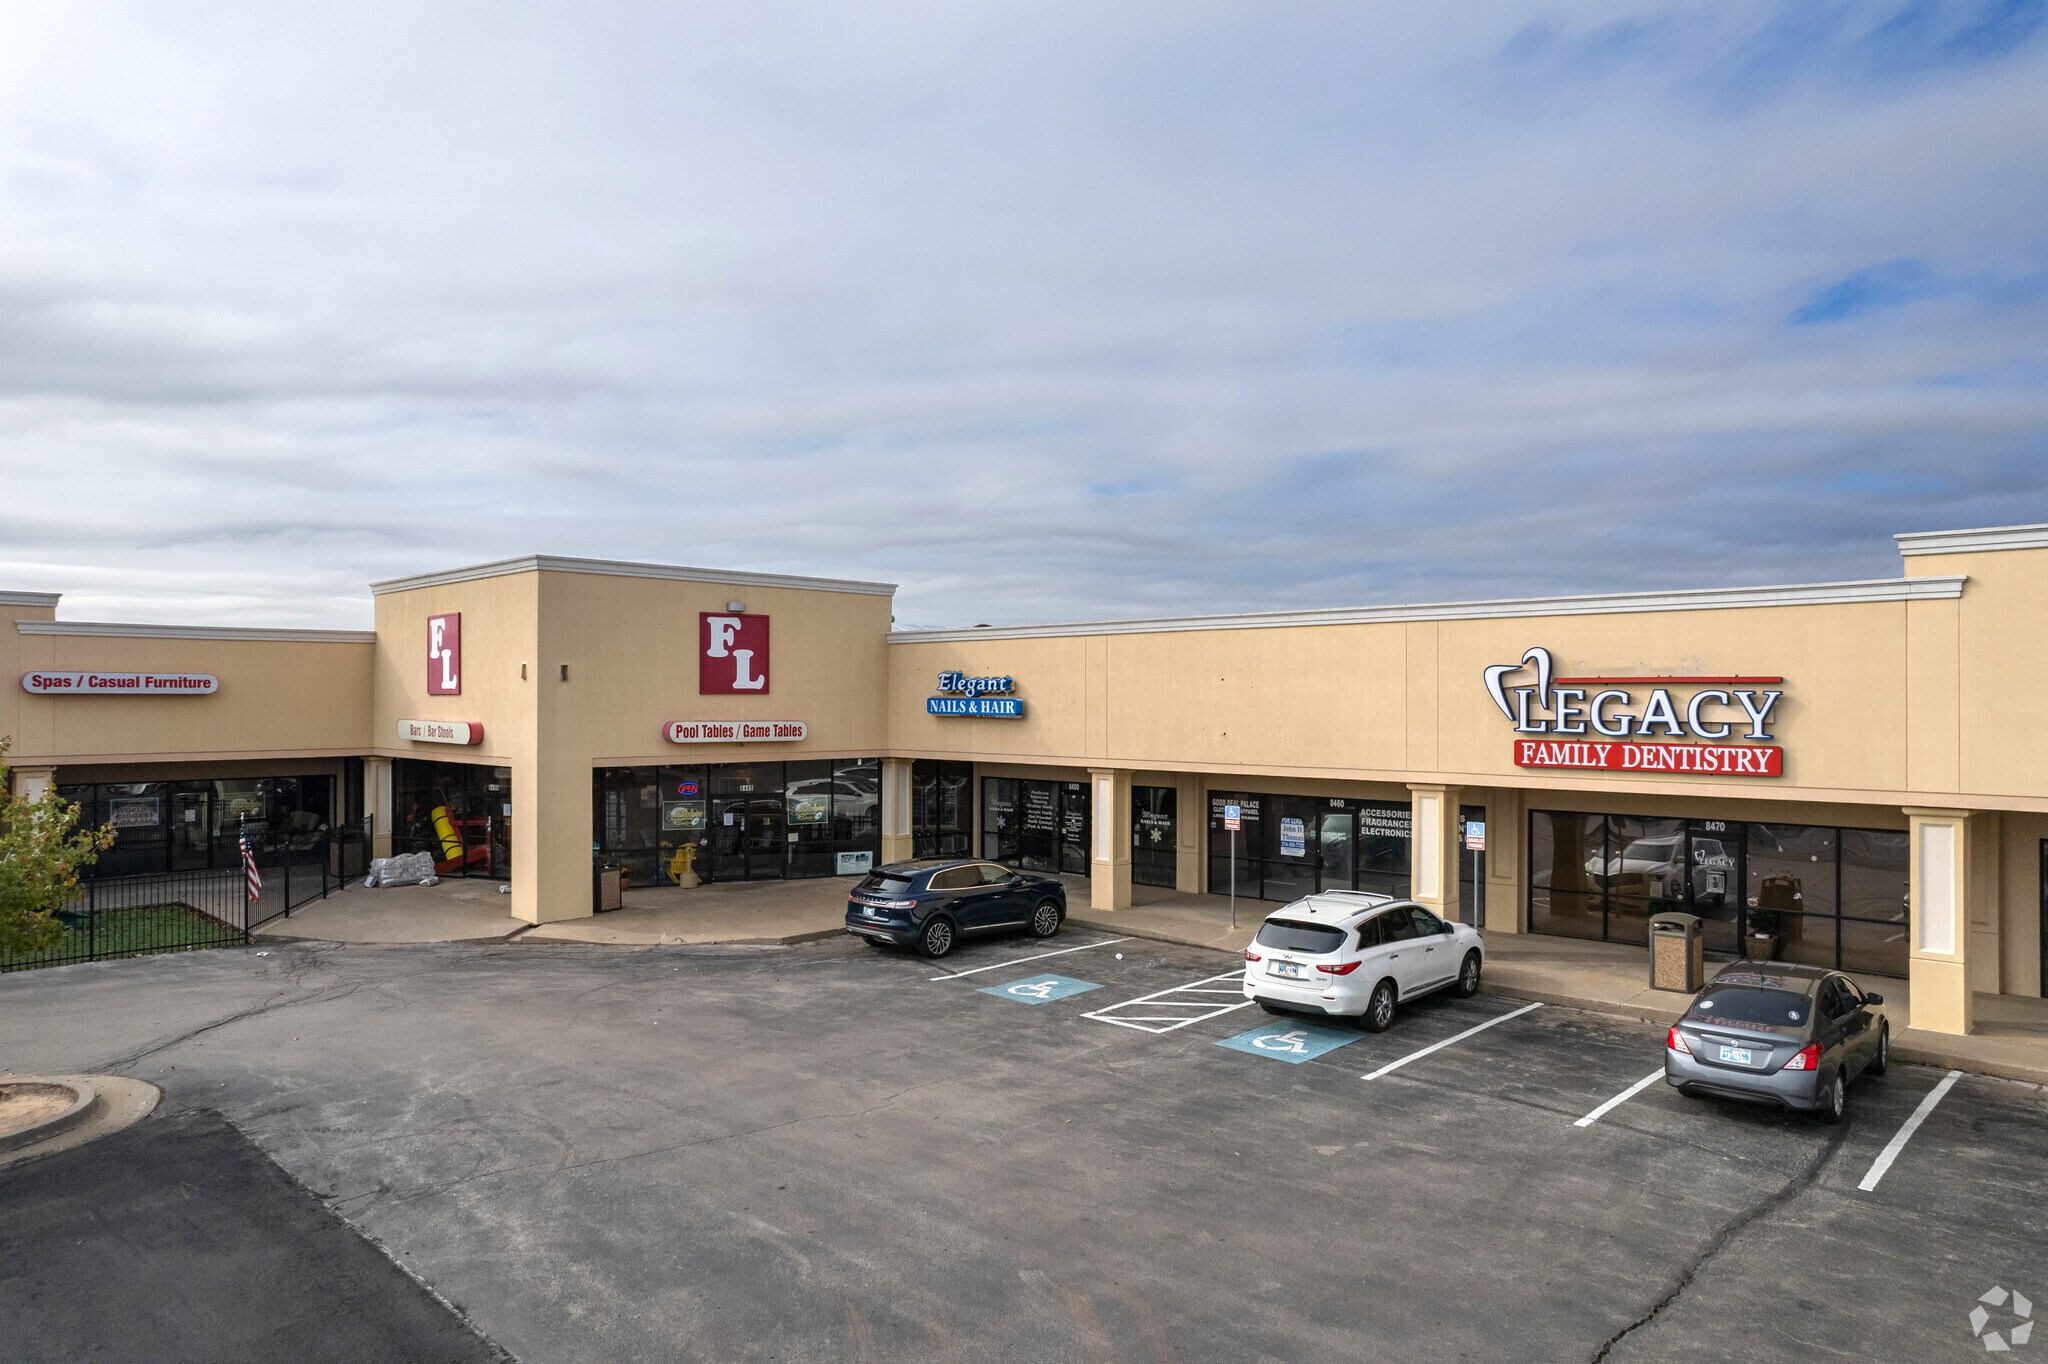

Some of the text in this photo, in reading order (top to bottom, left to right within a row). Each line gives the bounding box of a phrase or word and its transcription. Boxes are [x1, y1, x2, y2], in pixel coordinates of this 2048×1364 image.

[32, 675, 212, 690] Spas / Casual Furniture
[937, 673, 1007, 697] Elegant
[930, 700, 1015, 714] NAILS & HAIR
[1513, 688, 1783, 740] LEGACY
[410, 724, 421, 736] Bars
[428, 724, 437, 737] Bar
[438, 725, 454, 739] Stools
[676, 724, 699, 738] Pool
[702, 724, 734, 738] Tables
[743, 724, 770, 738] Game
[773, 723, 803, 737] Tables
[1521, 742, 1773, 773] FAMILY DENTISTRY
[1212, 798, 1226, 806] GOOD
[1240, 800, 1260, 809] PALACE
[1330, 799, 1345, 808] 8460
[1360, 808, 1412, 819] ACCESSORIE
[1705, 821, 1725, 832] 8470
[1282, 833, 1303, 841] Thomas
[1699, 858, 1735, 867] LEGACY
